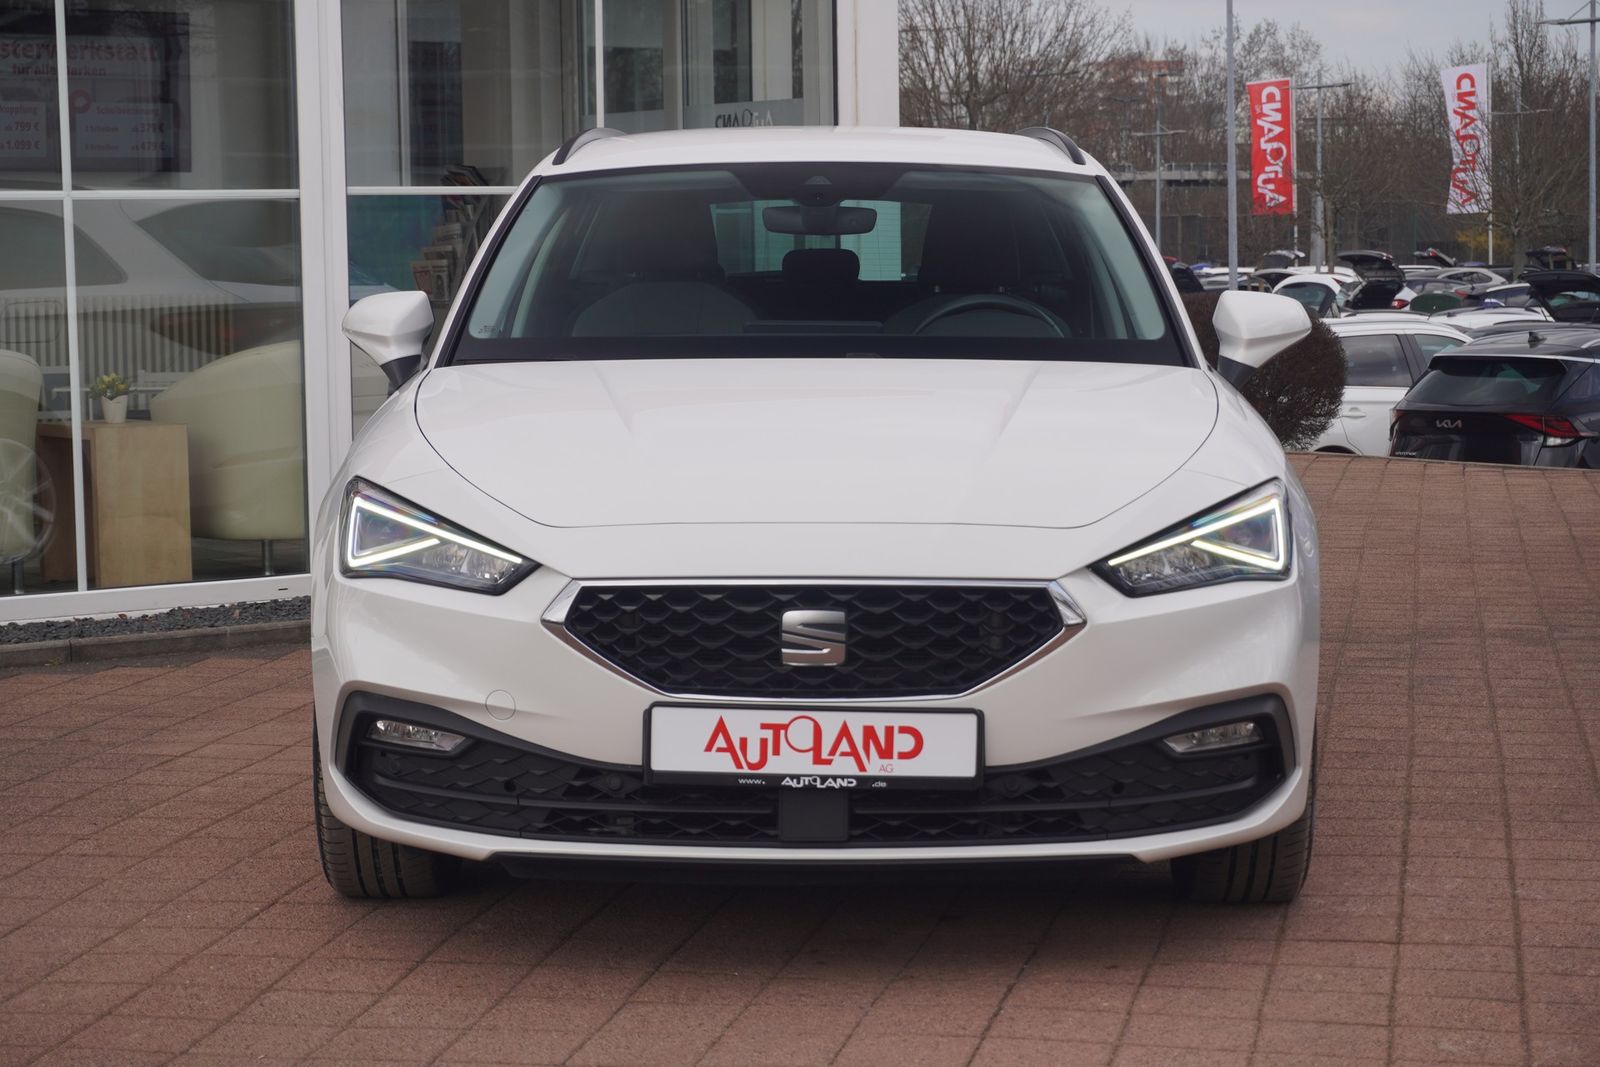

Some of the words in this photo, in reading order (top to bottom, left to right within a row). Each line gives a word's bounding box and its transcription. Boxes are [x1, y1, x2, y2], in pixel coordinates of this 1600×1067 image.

[1436, 419, 1462, 428] KIA
[703, 715, 924, 772] AUTOLAND
[878, 763, 894, 773] AG
[781, 775, 857, 789] AUTOLAND
